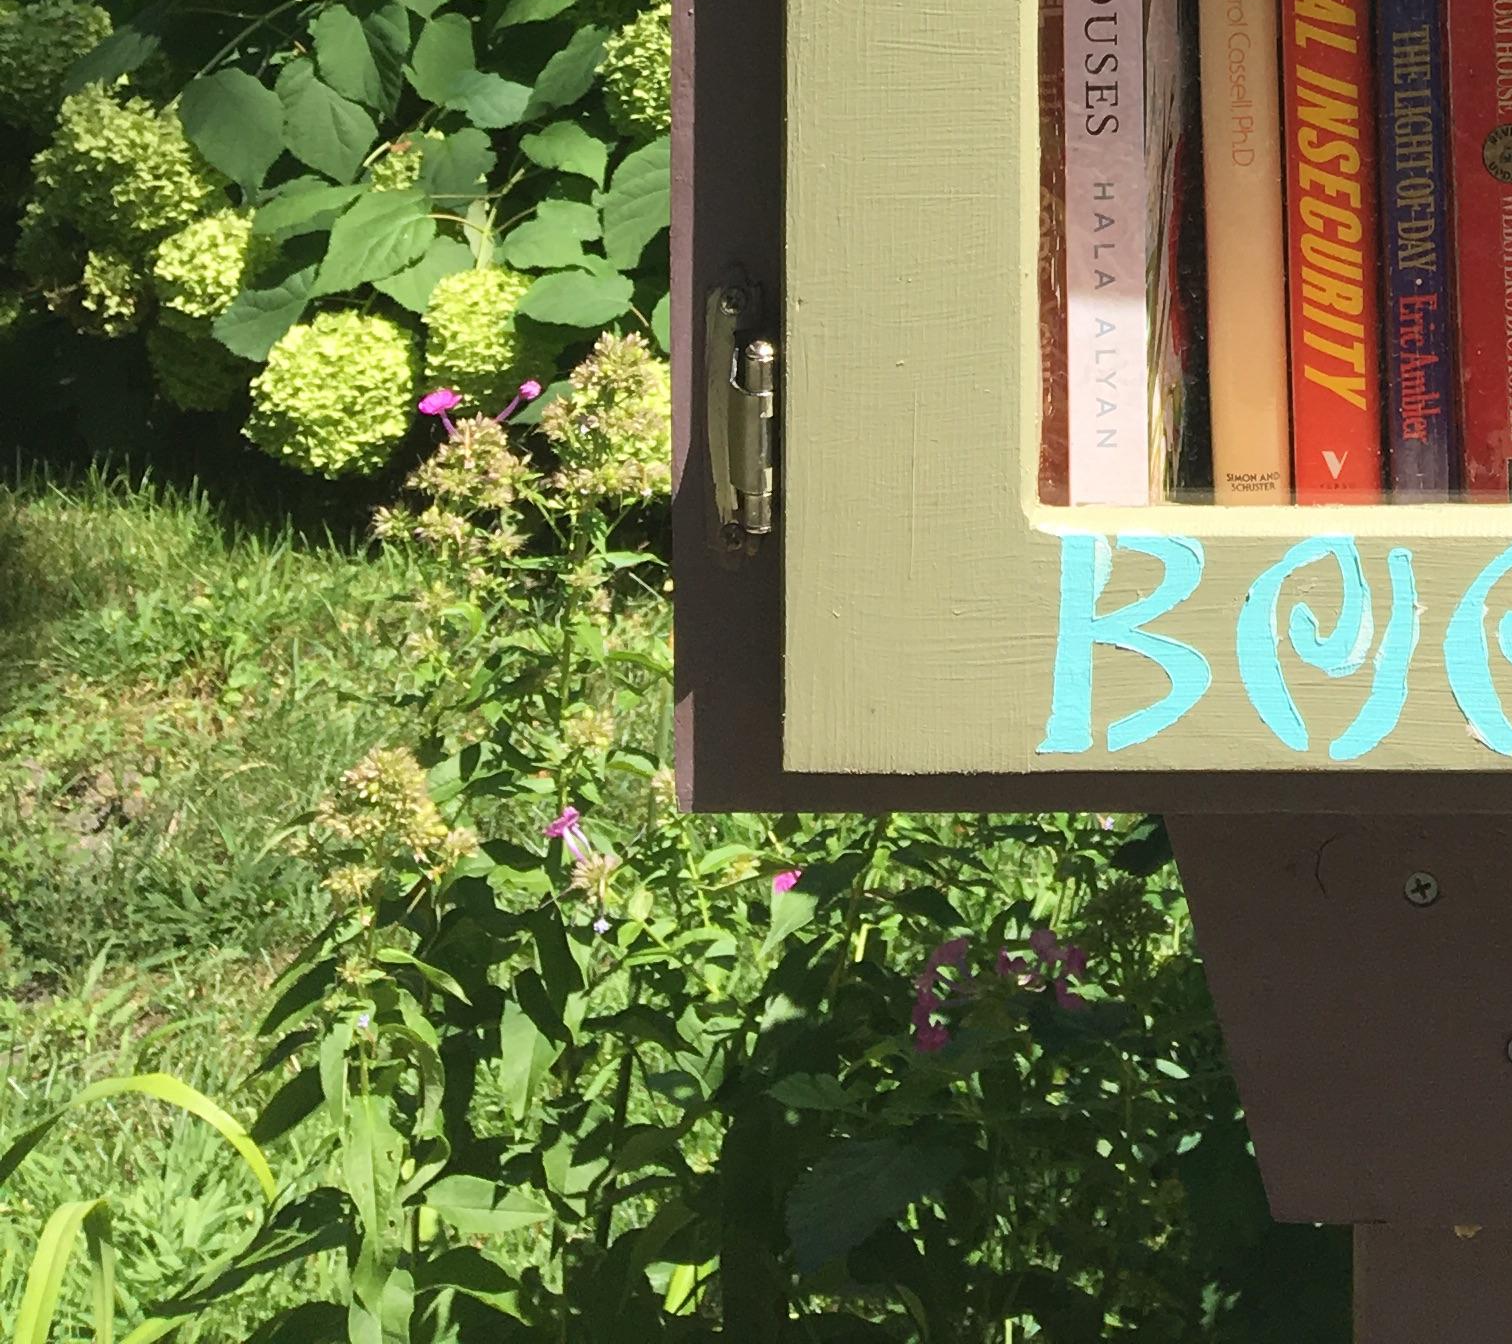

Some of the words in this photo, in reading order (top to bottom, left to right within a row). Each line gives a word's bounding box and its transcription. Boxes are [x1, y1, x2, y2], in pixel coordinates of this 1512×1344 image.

[1391, 23, 1432, 85] THE
[1393, 88, 1435, 173] LIGHT
[1395, 175, 1435, 212] OF
[1092, 181, 1116, 290] HALA
[1296, 63, 1368, 412] INSECURITY
[1397, 220, 1437, 273] DAY
[1399, 292, 1438, 350] Eric
[1094, 317, 1118, 449] ALYAN
[1400, 350, 1442, 443] Ambler
[1226, 472, 1258, 483] SIMON
[1260, 471, 1281, 482] AND
[1230, 481, 1277, 493] SCHUSTER
